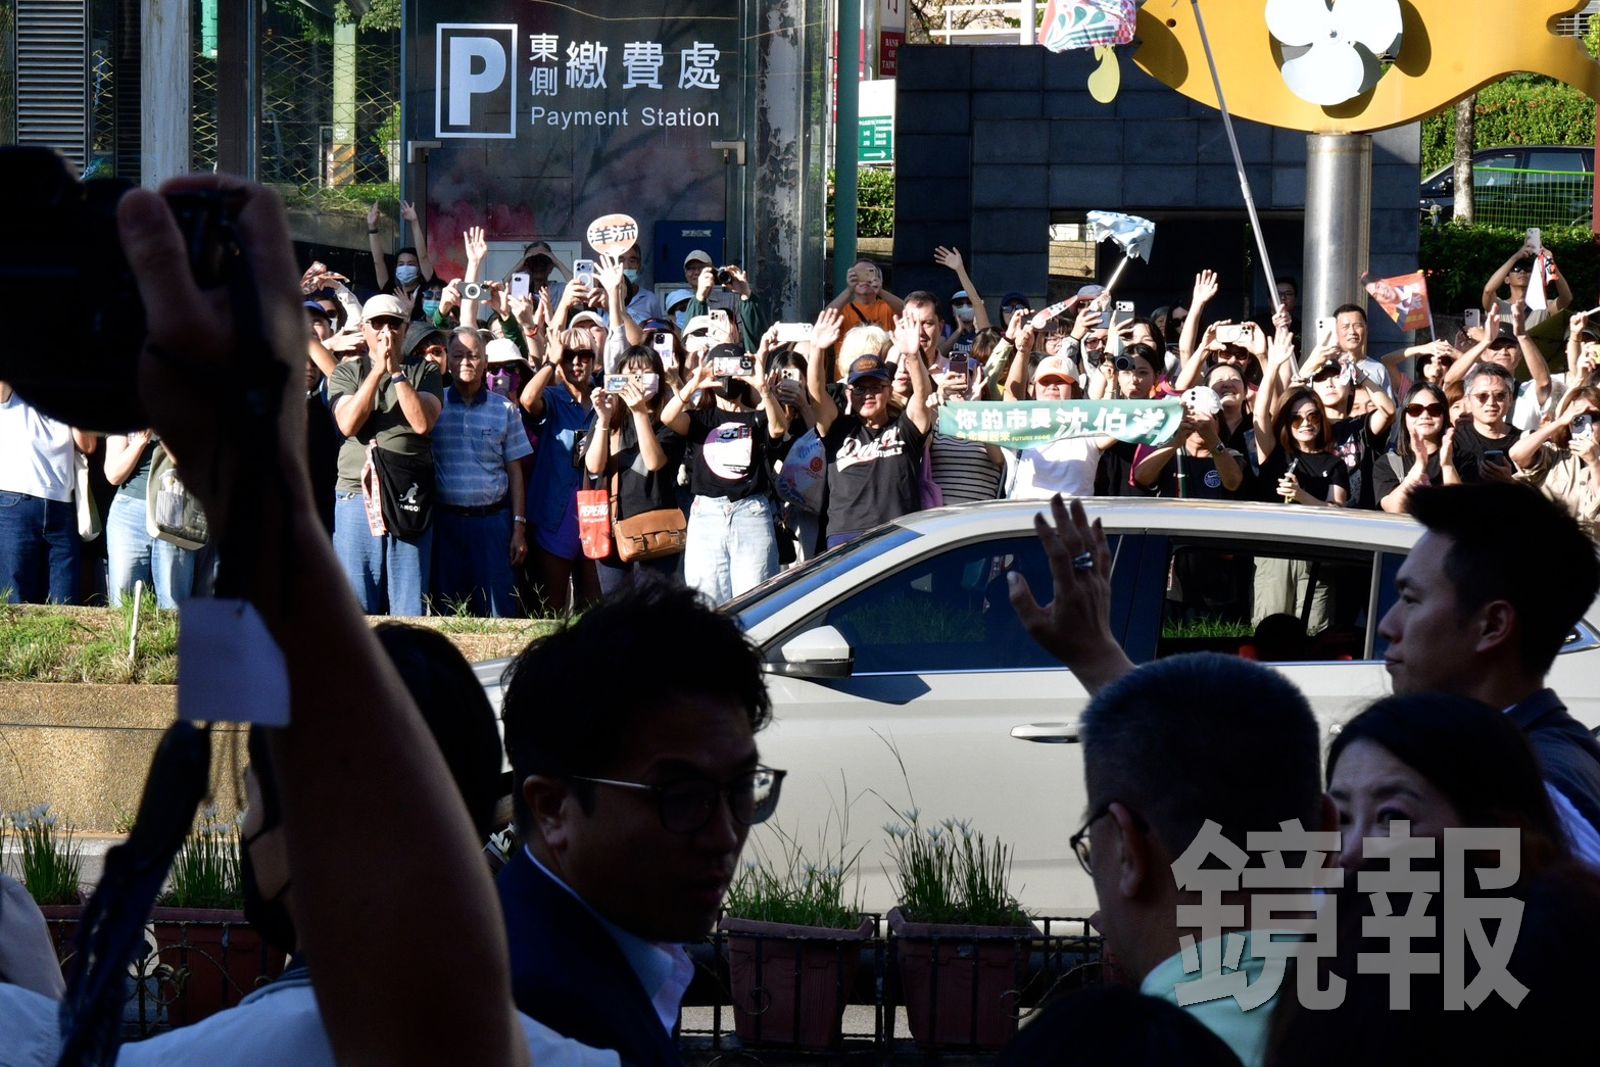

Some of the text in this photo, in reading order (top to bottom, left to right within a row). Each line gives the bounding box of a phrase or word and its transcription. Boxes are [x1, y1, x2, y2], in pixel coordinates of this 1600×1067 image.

[449, 37, 507, 126] P
[529, 33, 560, 97] 東側
[565, 41, 721, 90] 繳費處
[531, 106, 720, 131] Payment Station
[589, 222, 636, 245] 洋流
